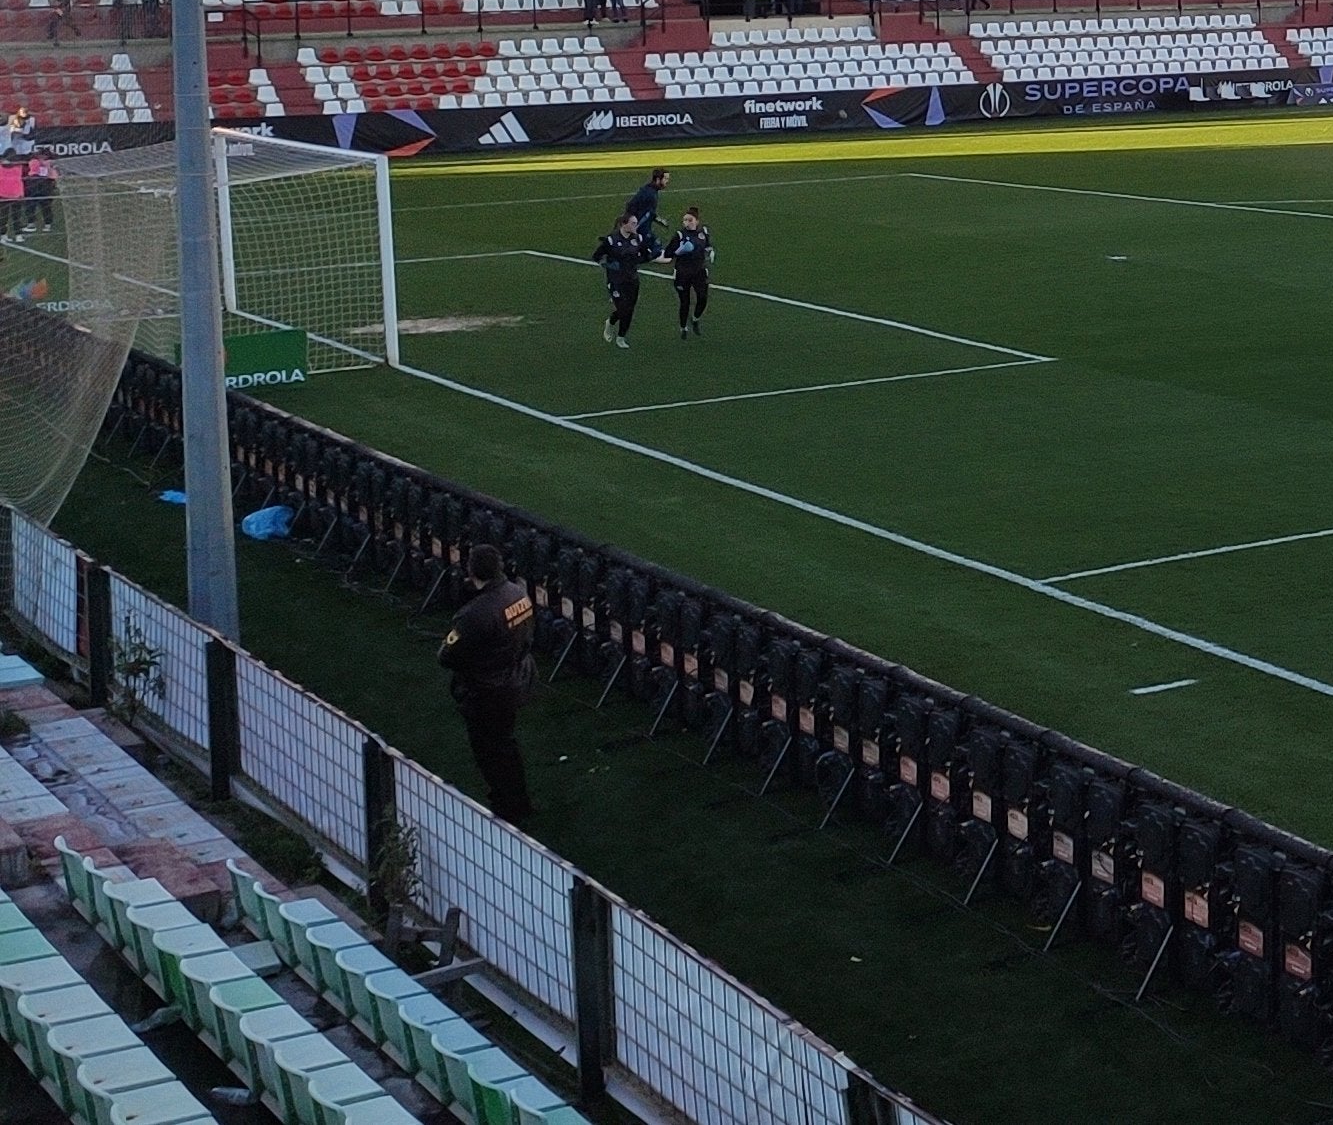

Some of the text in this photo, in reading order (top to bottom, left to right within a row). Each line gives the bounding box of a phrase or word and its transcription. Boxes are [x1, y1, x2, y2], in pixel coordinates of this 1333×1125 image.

[1024, 77, 1190, 101] SUPERCOPA
[743, 96, 823, 114] finetwork
[1063, 99, 1156, 114] DE ESPAÑA
[616, 113, 693, 128] IBERDROLA
[225, 368, 306, 389] RDROLA
